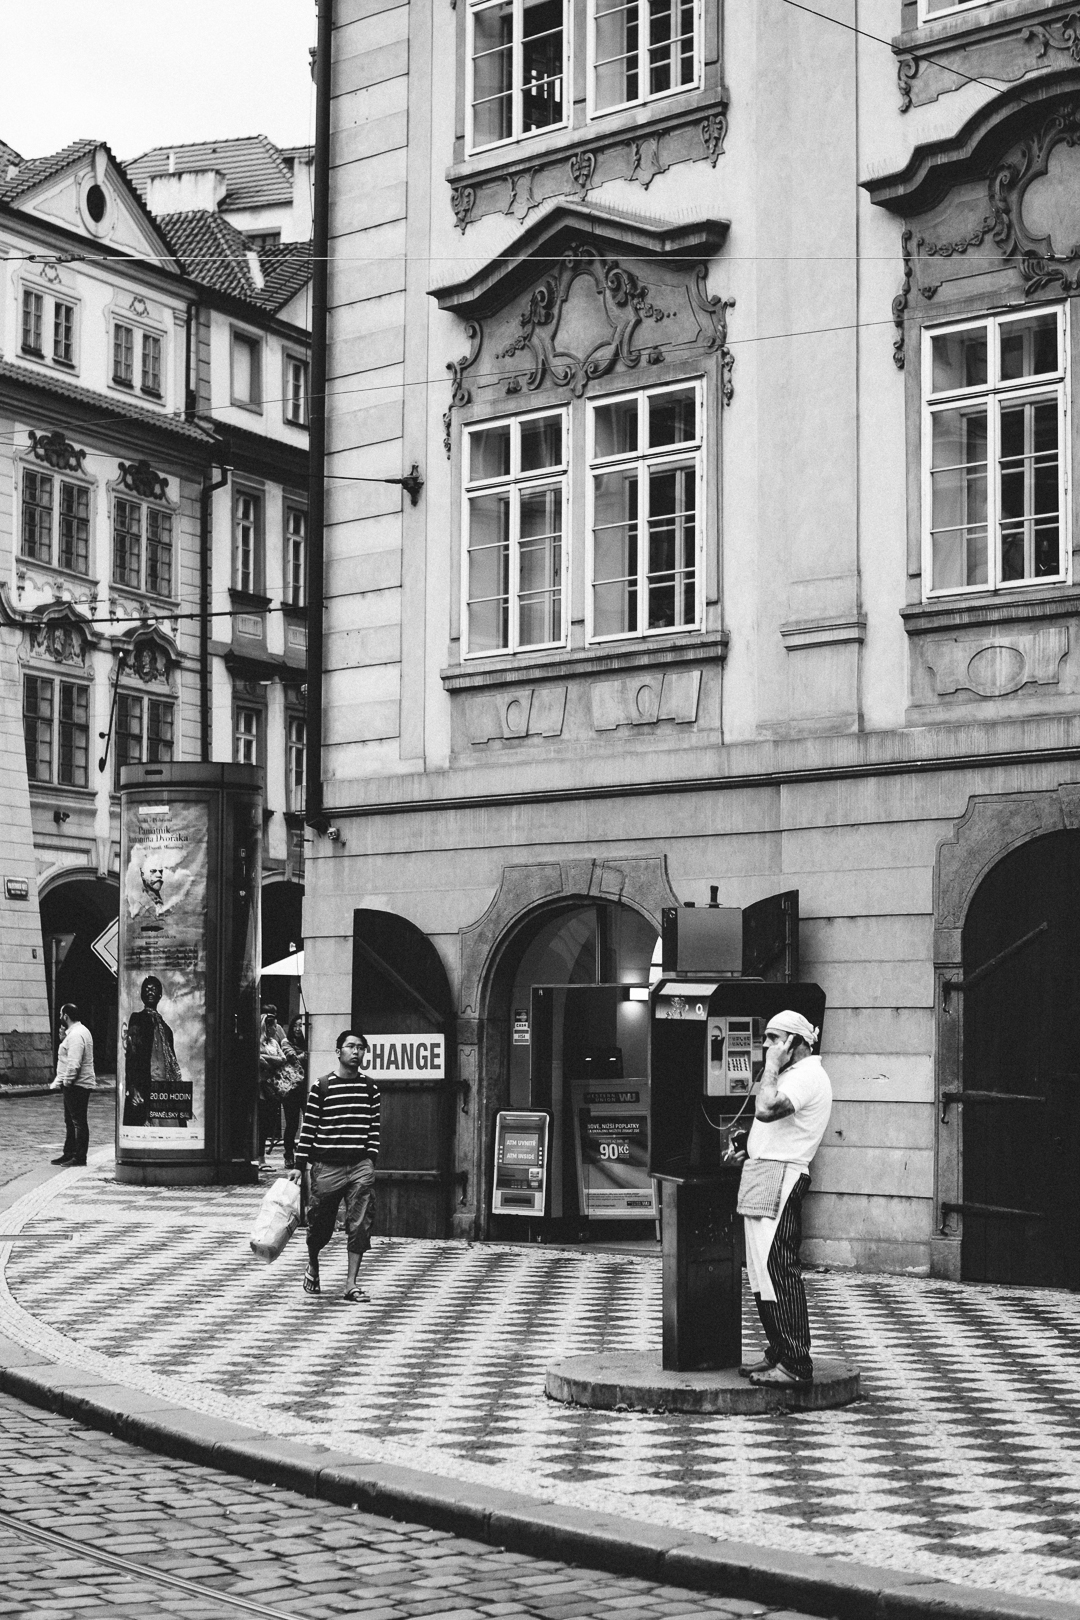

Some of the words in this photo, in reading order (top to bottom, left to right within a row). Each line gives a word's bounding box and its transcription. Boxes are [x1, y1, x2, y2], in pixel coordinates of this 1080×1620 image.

[359, 1042, 441, 1070] CHANGE
[149, 1092, 168, 1100] 20:00
[618, 1093, 636, 1102] WU
[599, 1143, 618, 1159] 90
[506, 1152, 517, 1160] ATM
